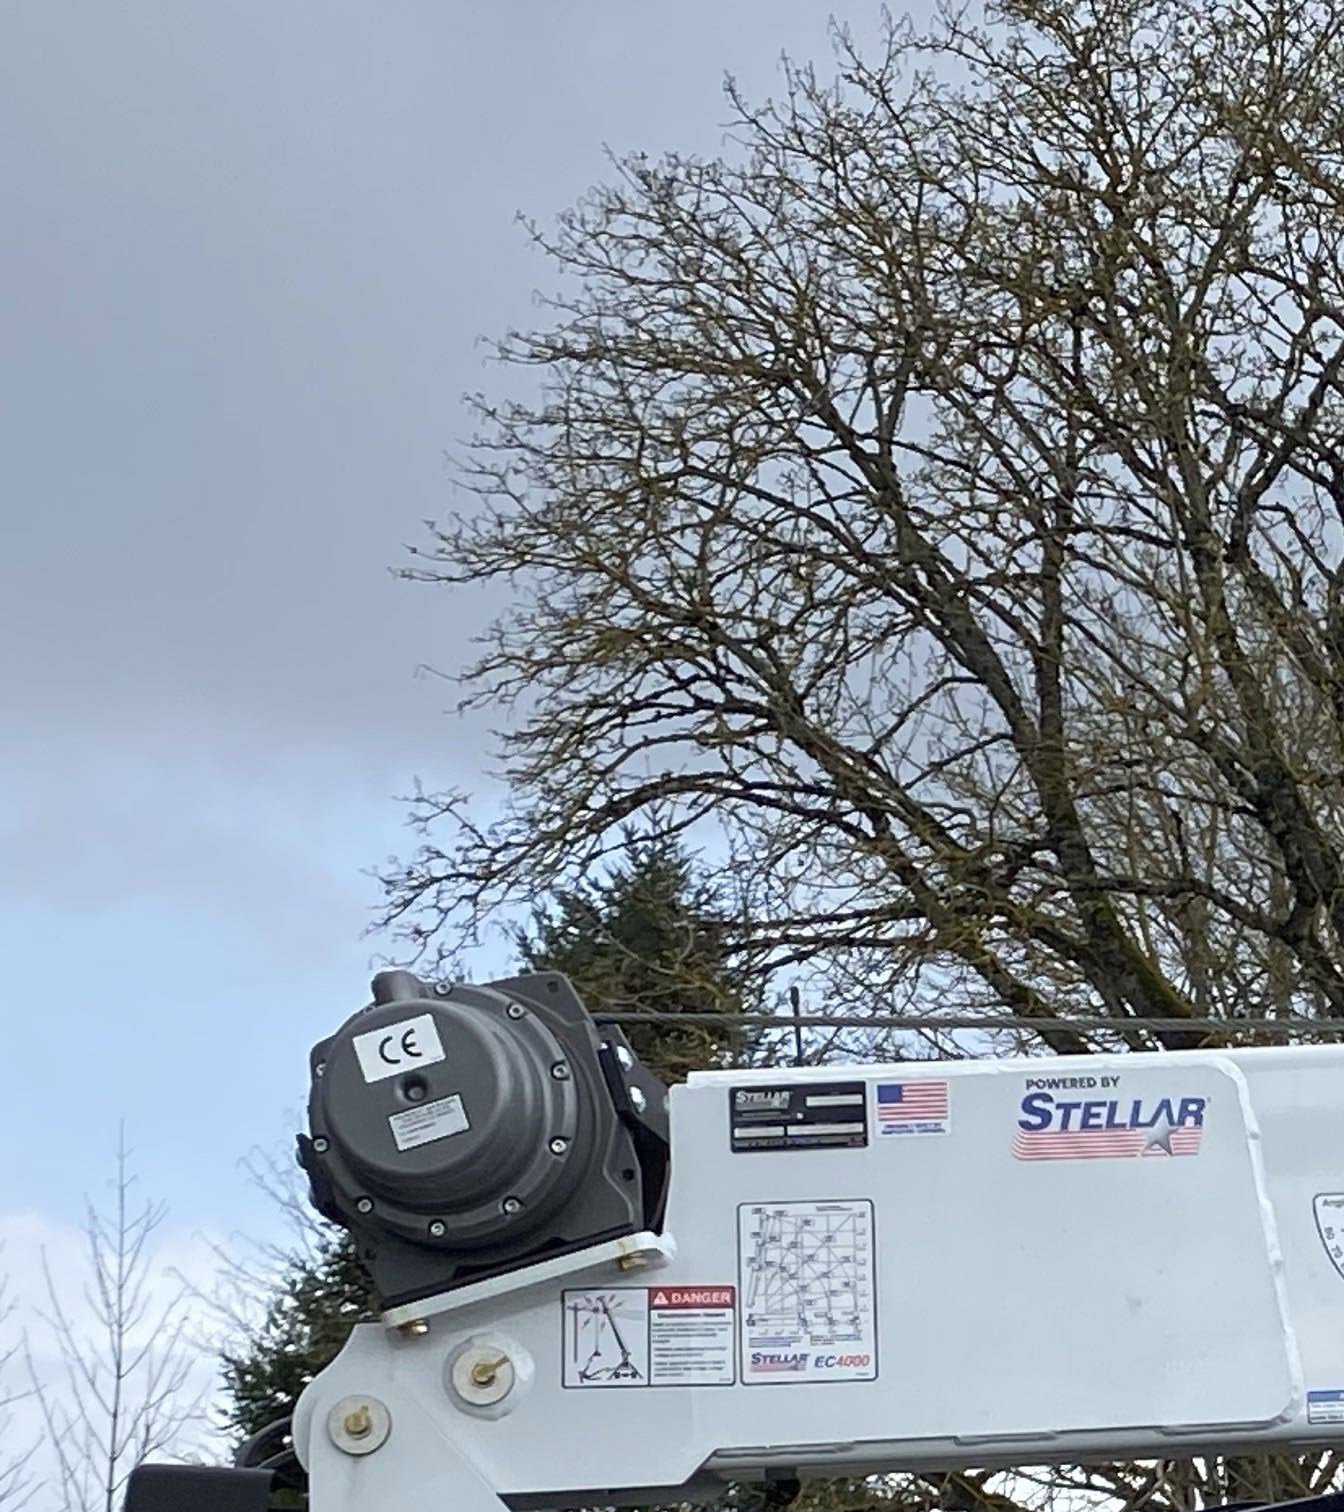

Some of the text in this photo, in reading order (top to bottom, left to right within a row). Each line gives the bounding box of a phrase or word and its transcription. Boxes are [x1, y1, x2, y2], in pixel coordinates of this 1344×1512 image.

[1026, 1076, 1120, 1090] POWERED BY
[736, 1091, 790, 1103] STELLAR
[1018, 1092, 1206, 1131] STELLAR
[1331, 1246, 1343, 1258] 70
[671, 1292, 731, 1304] DANGER
[751, 1352, 870, 1368] STELLAR EC4000
